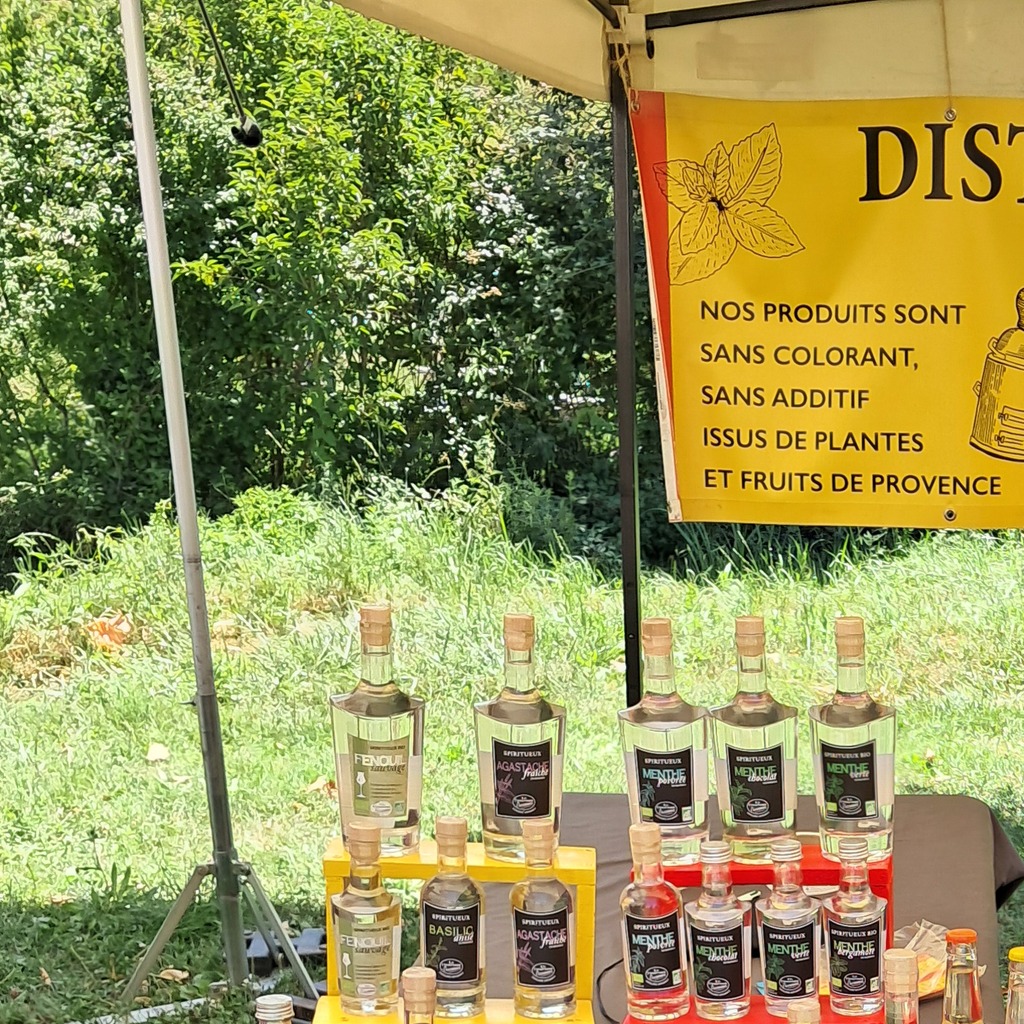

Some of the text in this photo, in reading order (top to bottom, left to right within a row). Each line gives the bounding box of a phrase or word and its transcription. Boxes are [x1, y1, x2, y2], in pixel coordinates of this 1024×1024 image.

[700, 301, 966, 326] NOS PRODUITS SONT
[700, 344, 919, 371] SANS COLORANT,
[701, 386, 870, 410] SANS ADDITIF
[702, 430, 924, 453] ISSUS DE PLANTES
[704, 469, 1002, 496] ET FRUITS DE PROVENCE
[736, 755, 773, 763] SPIRITUEUX
[496, 760, 550, 773] AGASTACHE
[734, 765, 777, 777] MENTHE
[826, 762, 870, 775] MENTHE
[642, 767, 687, 781] MENTHE
[431, 913, 471, 921] SPIRITUEUX
[521, 918, 560, 926] SPIRITUEUX
[429, 924, 475, 938] BASILIC
[633, 922, 671, 930] SPIRITUEUX
[517, 927, 567, 942] AGASTACHE
[631, 931, 675, 946] MENTHE
[768, 932, 806, 940] SPIRITUEUX
[830, 929, 866, 938] SPIRITUEUX
[695, 944, 738, 957] MENTHE
[767, 942, 810, 955] MENTHE
[833, 940, 876, 952] MENTHE
